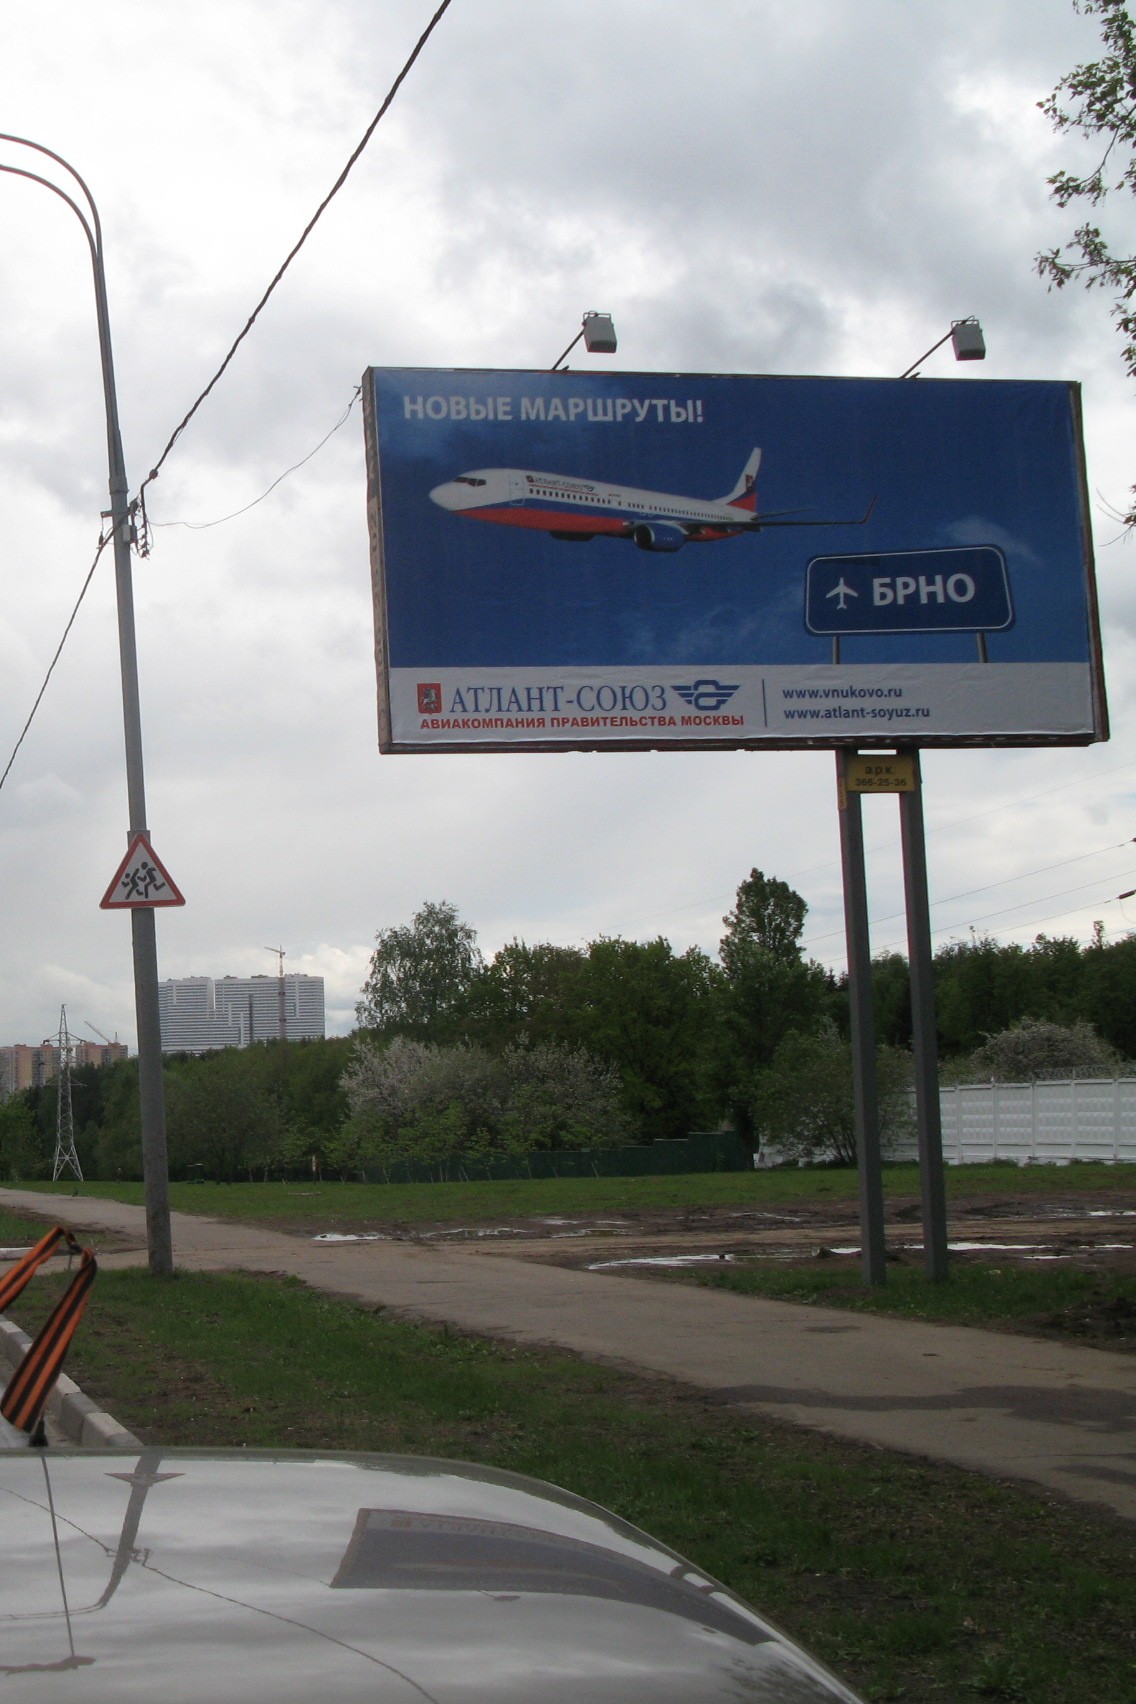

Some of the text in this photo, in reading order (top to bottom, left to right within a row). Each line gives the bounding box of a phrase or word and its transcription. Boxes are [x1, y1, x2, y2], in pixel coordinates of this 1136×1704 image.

[403, 395, 705, 424] НОВЫЕ МАРШРУТЫ!
[872, 573, 976, 606] БРНО
[449, 685, 668, 713] АТЛАНТ-СОЮЗ
[782, 686, 903, 699] www.vnukovo.ru
[420, 715, 745, 730] АВИАКОМПАНИЯ ПРАВИТЕЛЬСТВА МОСКВЫ
[784, 706, 931, 721] www.atlant-soyuz.ru
